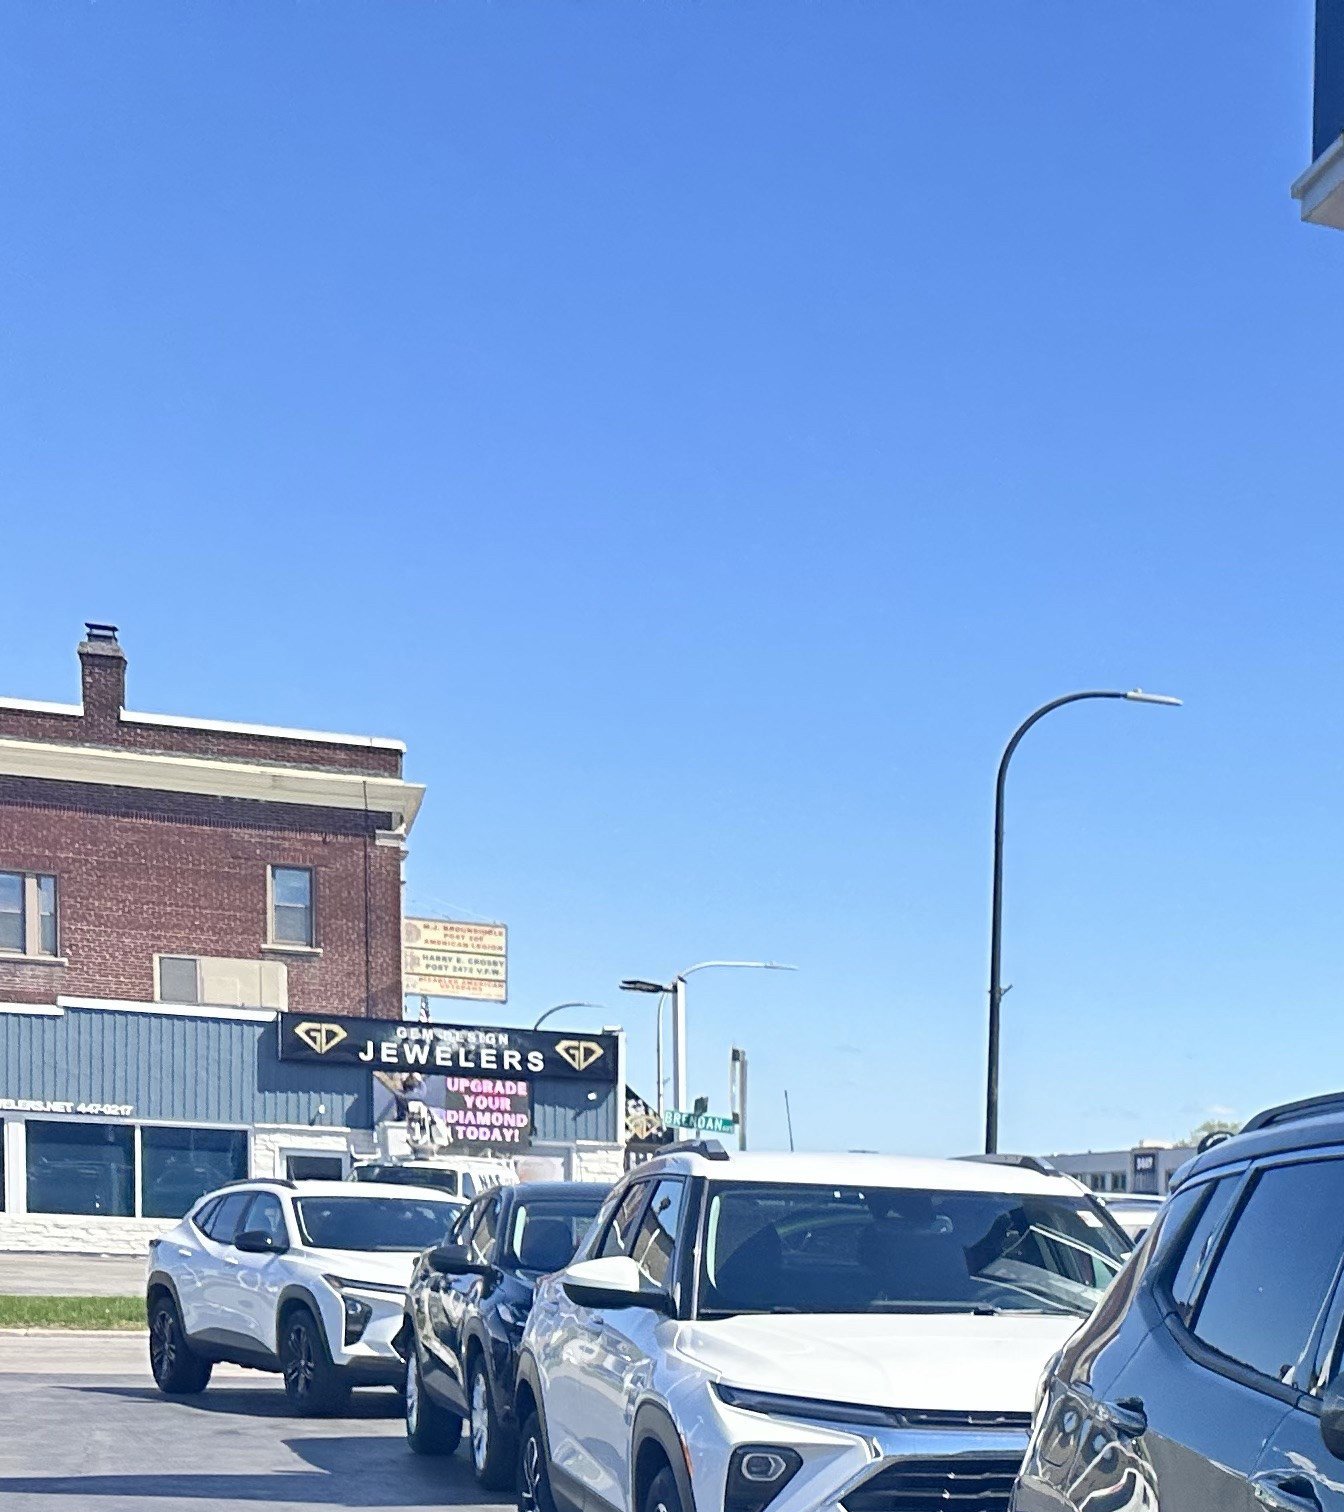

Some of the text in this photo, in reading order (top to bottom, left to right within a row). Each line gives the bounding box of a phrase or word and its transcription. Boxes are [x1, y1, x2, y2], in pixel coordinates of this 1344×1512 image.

[422, 953, 453, 963] HARRY
[467, 958, 504, 968] CROSBY
[425, 963, 449, 971] POST
[396, 1026, 510, 1046] GEM DESIGN
[358, 1040, 545, 1072] JEWELERS
[446, 1077, 529, 1097] UPGRADE
[463, 1094, 512, 1112] YOUR
[446, 1110, 529, 1128] DIAMOND
[664, 1110, 722, 1131] BRENDAN
[456, 1124, 520, 1143] TODAY!
